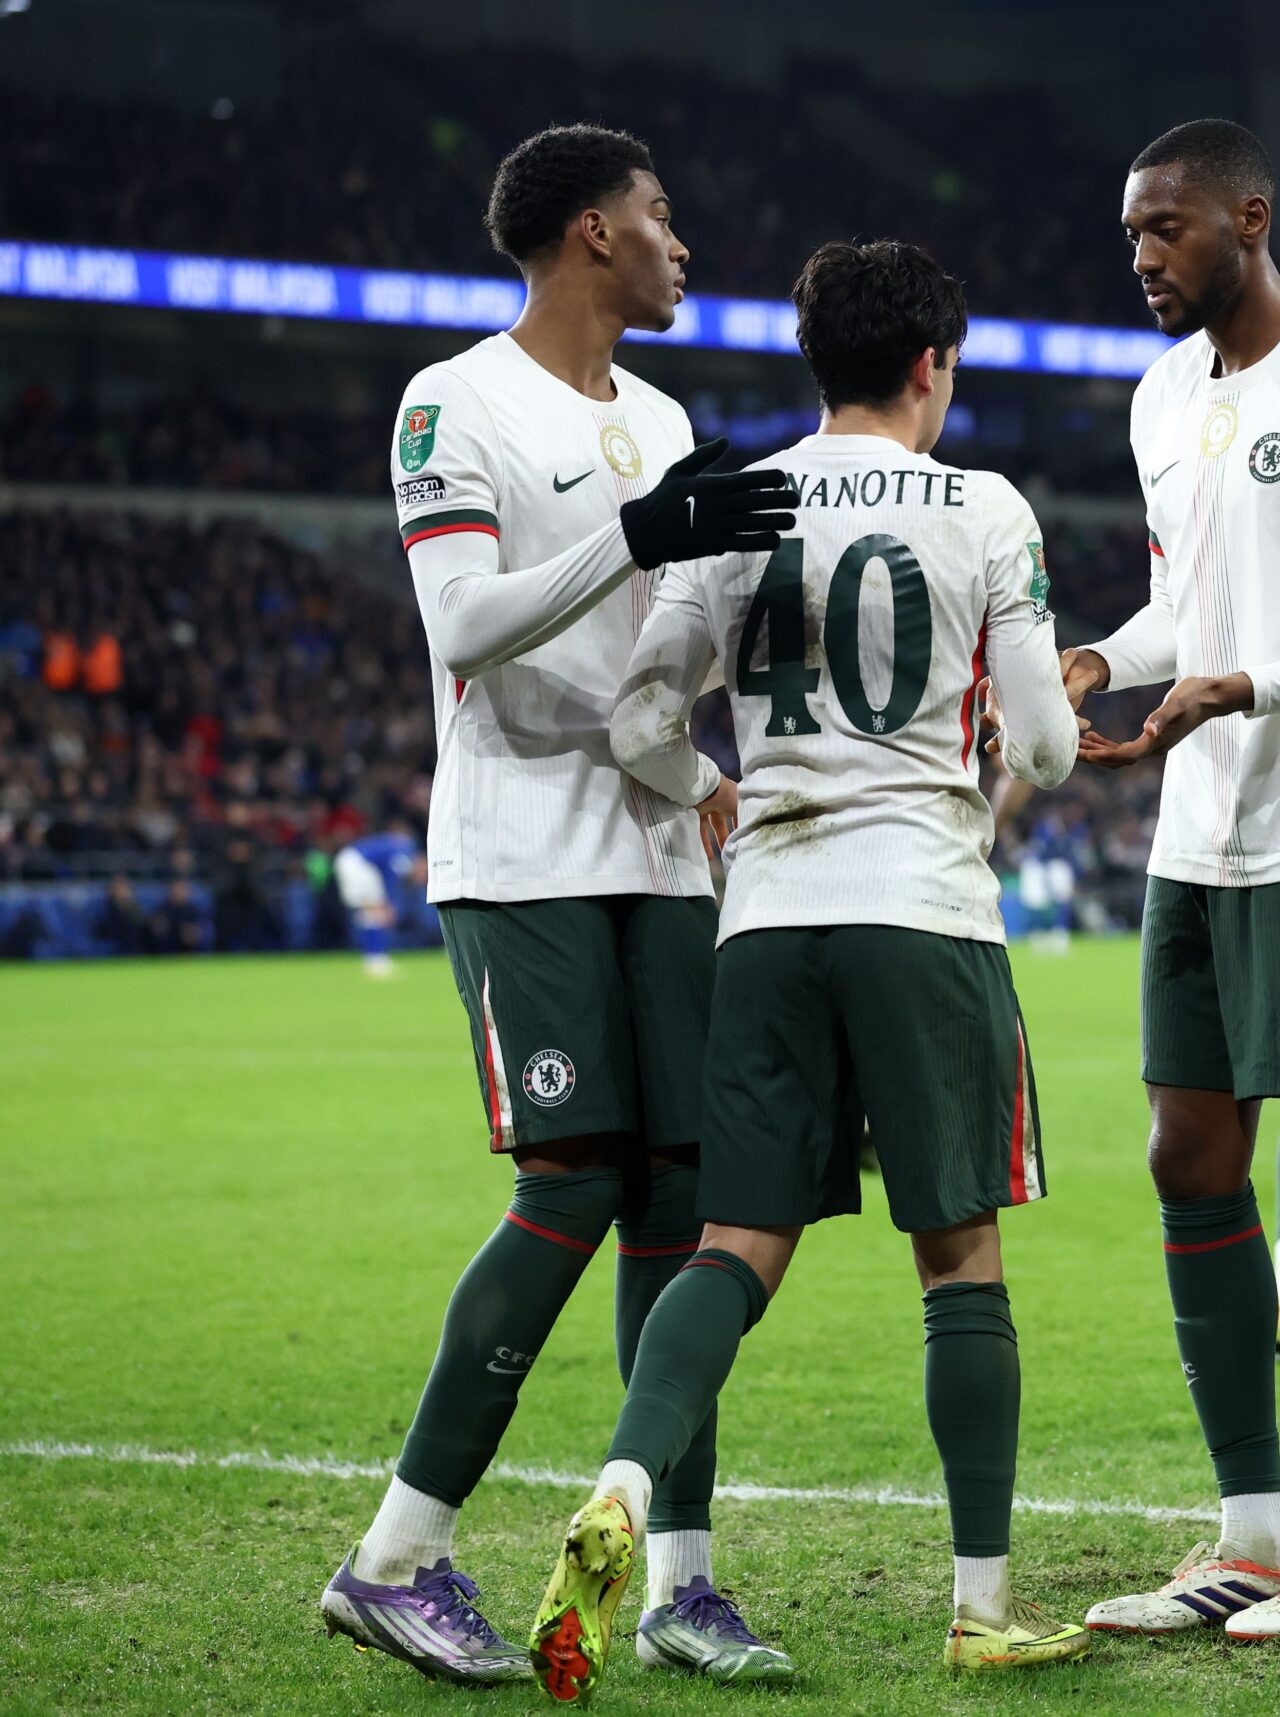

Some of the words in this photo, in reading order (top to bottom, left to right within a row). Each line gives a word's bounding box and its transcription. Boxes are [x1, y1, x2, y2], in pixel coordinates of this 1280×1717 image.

[407, 438, 422, 449] Cup
[408, 480, 440, 495] room
[409, 488, 446, 503] racism
[785, 470, 965, 509] NANOTTE
[737, 533, 932, 735] 40
[530, 1051, 564, 1068] CHELSEA
